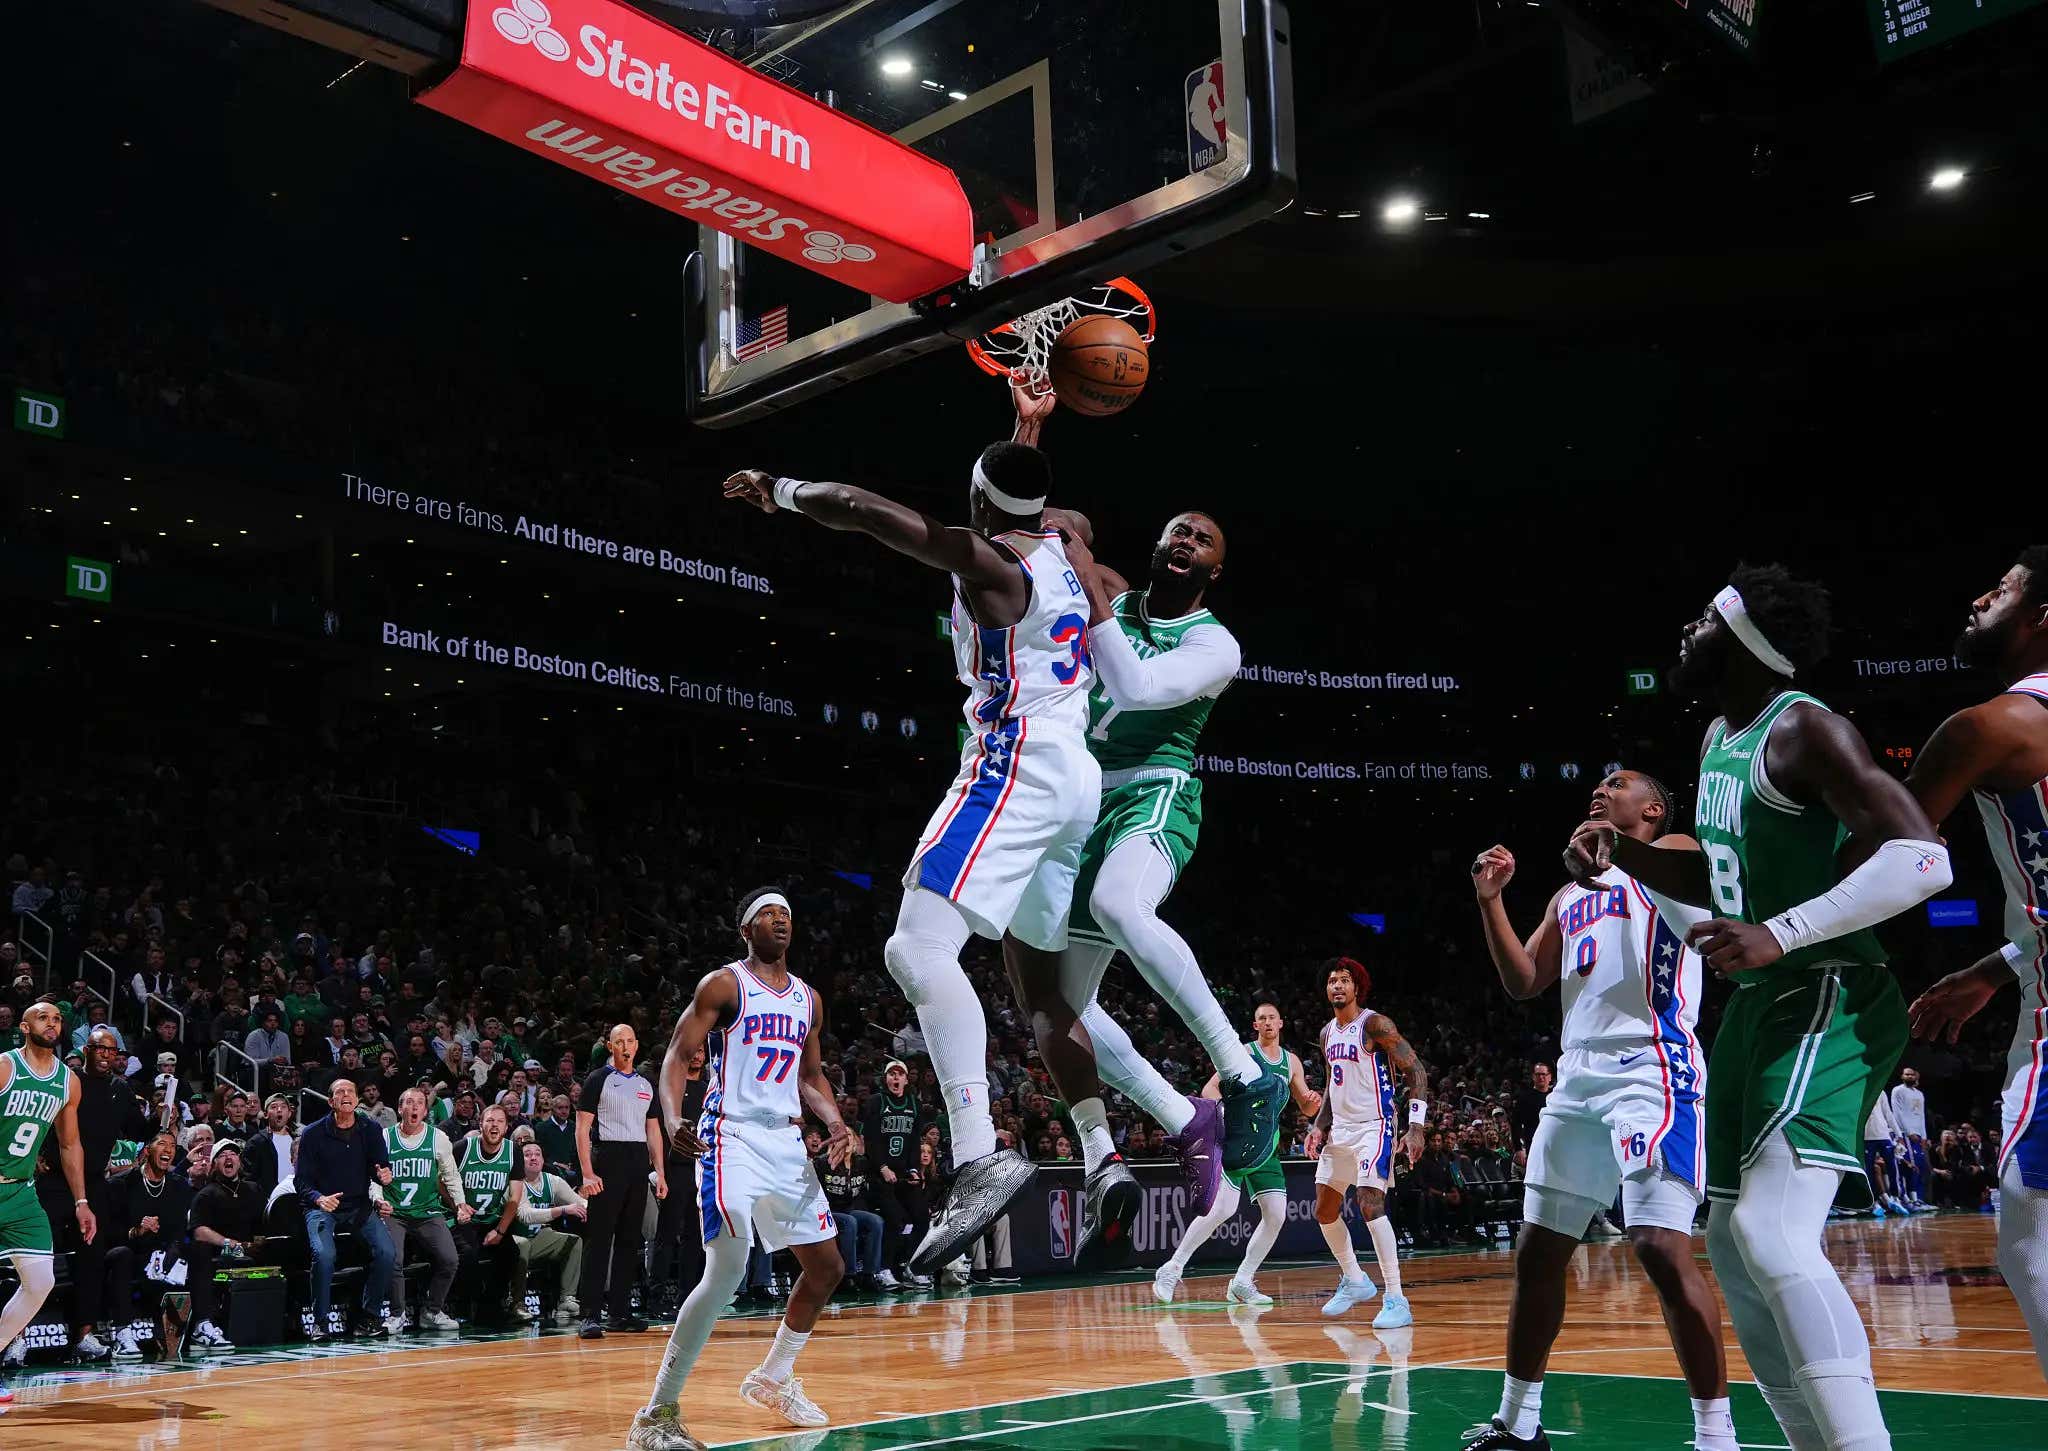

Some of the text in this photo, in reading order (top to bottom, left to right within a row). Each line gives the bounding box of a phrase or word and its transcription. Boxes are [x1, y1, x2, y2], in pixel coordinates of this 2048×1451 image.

[1901, 6, 1931, 26] HAUSER
[1195, 146, 1216, 169] NBA
[21, 396, 59, 428] TD
[341, 473, 774, 595] There are fans. And there are Boston fans.
[72, 564, 107, 593] TD
[1152, 631, 1179, 643] Amica
[382, 622, 797, 717] Bank of the Boston Celtics. Fan of the fans.
[1236, 665, 1460, 692] nd there's Boston fired up.
[1852, 658, 1911, 676] There
[1915, 657, 1948, 673] are
[1630, 673, 1655, 690] TD
[1728, 748, 1752, 759] Amica
[1208, 755, 1234, 773] the
[1237, 757, 1292, 777] Boston
[1295, 761, 1361, 779] Celtics.
[1365, 762, 1396, 779] Fan
[1400, 762, 1416, 779] of
[1419, 762, 1448, 779] the
[1451, 762, 1492, 779] fans.
[1560, 885, 1632, 937] PHILA
[1576, 934, 1597, 978] 0
[742, 1012, 808, 1052] PHILA
[1326, 1042, 1360, 1063] PHILA
[756, 1046, 796, 1084] 77
[1333, 1064, 1345, 1087] 9
[4, 1089, 63, 1123] BOSTON
[1411, 1102, 1419, 1113] 9
[881, 1115, 915, 1134] CELTICS
[8, 1122, 40, 1158] 9
[889, 1135, 904, 1157] 9
[1620, 1132, 1646, 1162] 76
[464, 1171, 509, 1191] BOSTON
[400, 1182, 418, 1206] 7
[476, 1193, 493, 1215] 7
